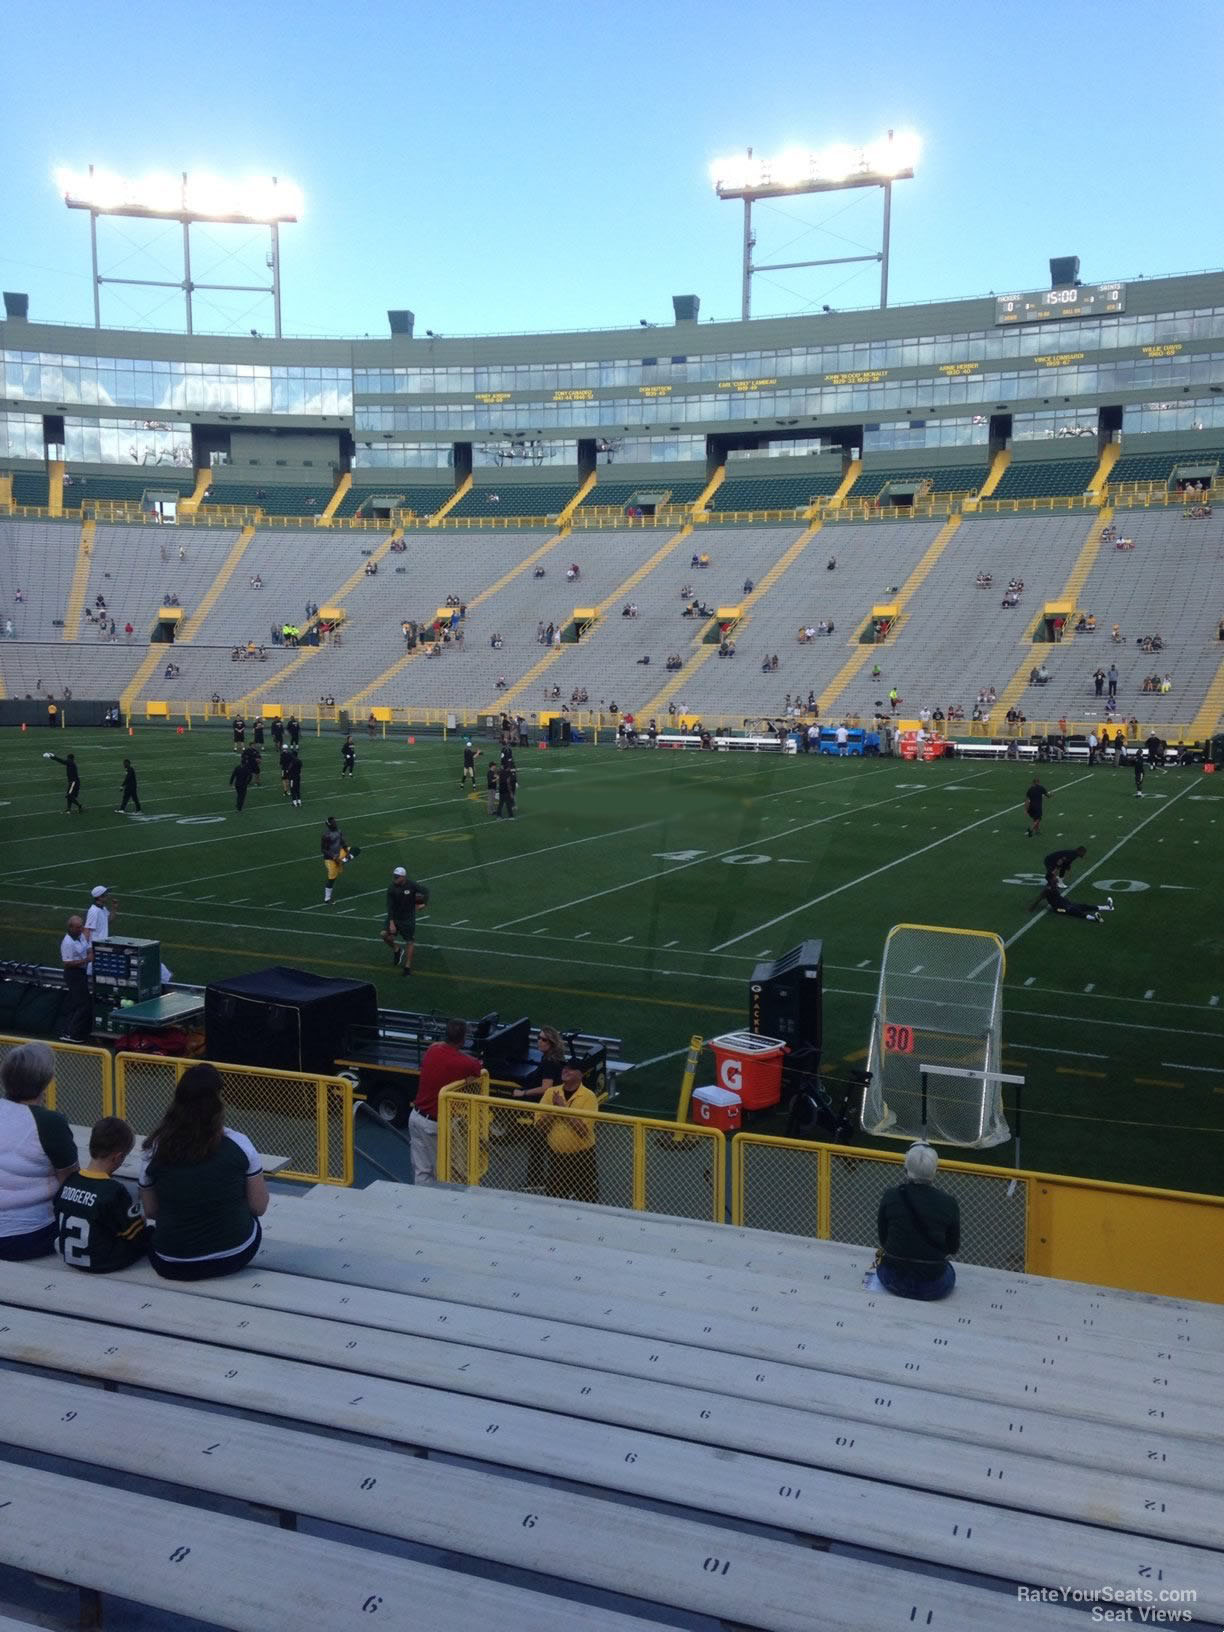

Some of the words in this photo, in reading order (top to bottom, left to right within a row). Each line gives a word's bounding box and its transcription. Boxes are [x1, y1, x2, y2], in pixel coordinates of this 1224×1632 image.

[1046, 289, 1077, 304] 15:00
[885, 1026, 910, 1050] 30
[721, 1059, 742, 1090] G
[701, 1104, 710, 1120] G
[60, 1186, 97, 1207] RODGERS
[168, 1545, 191, 1564] 8
[702, 1557, 731, 1576] 10
[909, 1605, 934, 1625] 11
